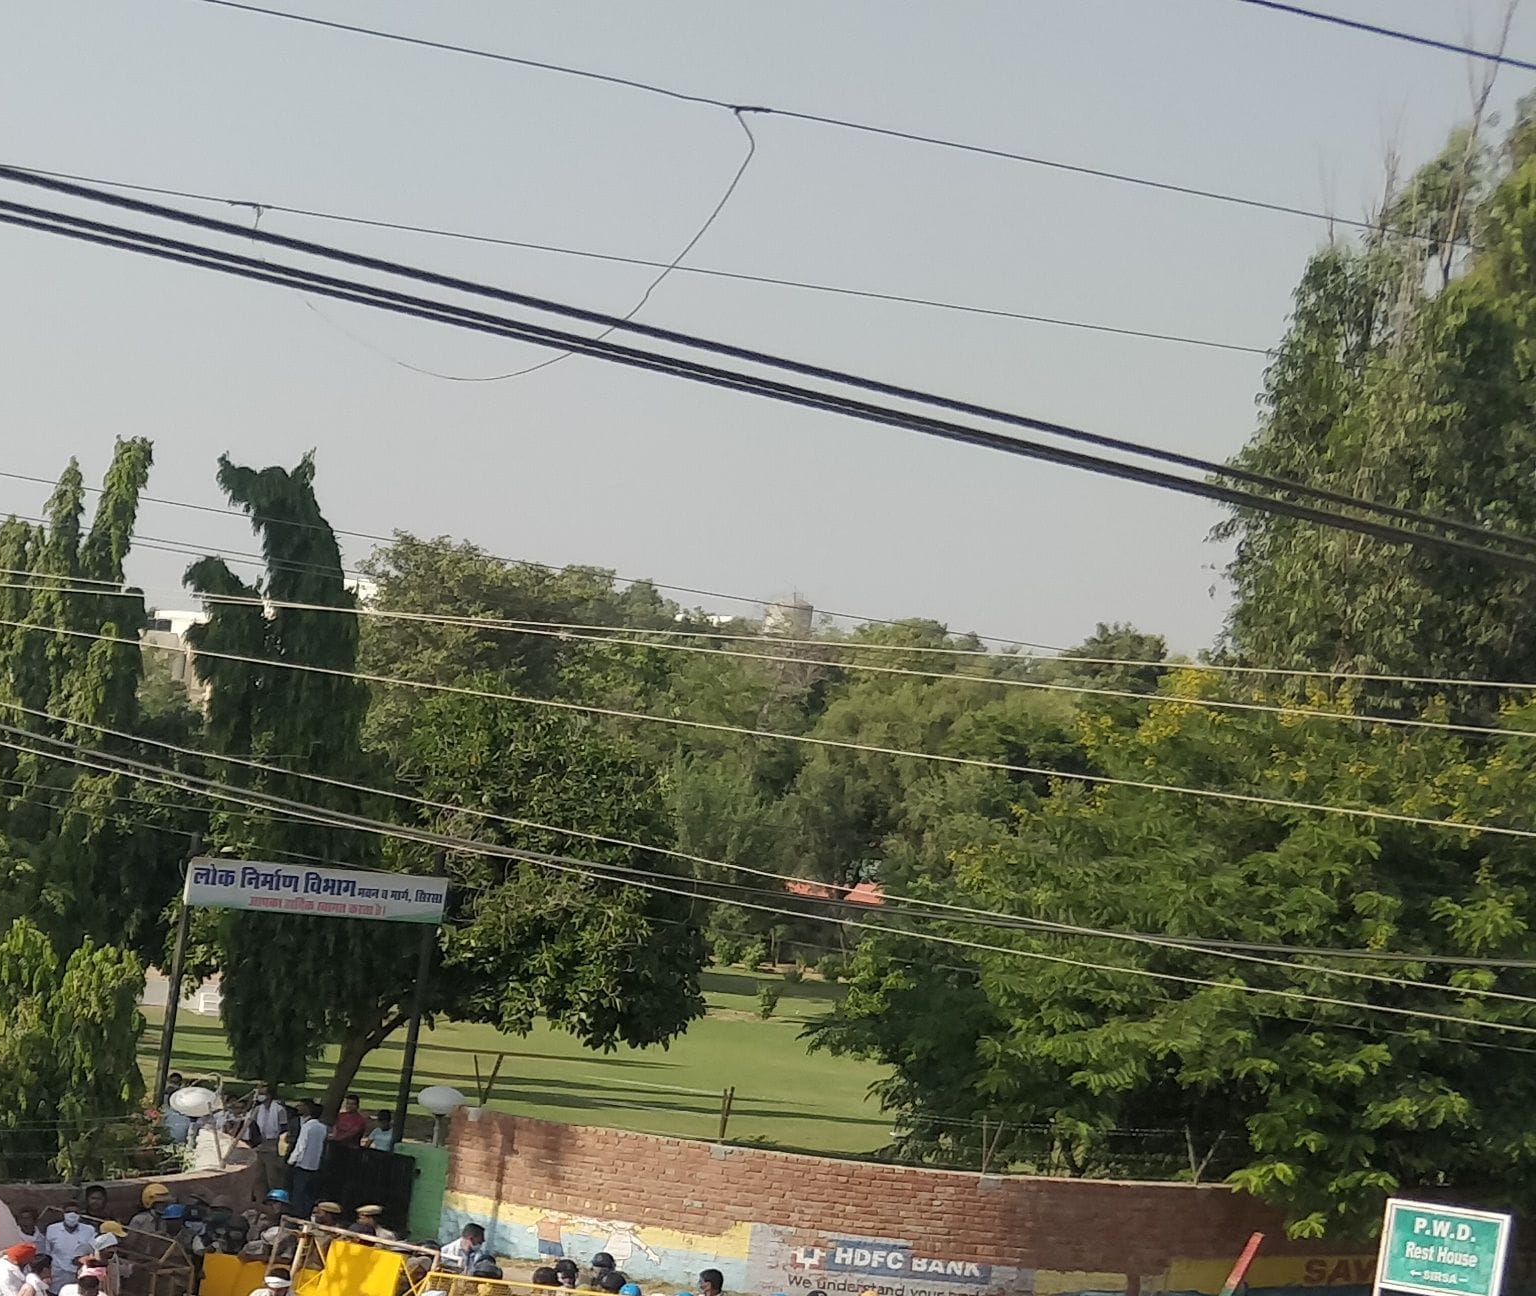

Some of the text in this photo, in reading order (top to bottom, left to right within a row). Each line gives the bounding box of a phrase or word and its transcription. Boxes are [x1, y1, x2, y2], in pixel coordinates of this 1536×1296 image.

[193, 863, 235, 887] लोक
[240, 866, 300, 893] निर्माण
[303, 871, 356, 897] विभाग
[1413, 1216, 1476, 1243] P.W.D.
[834, 1247, 982, 1278] HDFC BANK
[1404, 1241, 1478, 1268] Rest House
[788, 1274, 813, 1289] We
[1422, 1269, 1457, 1284] SIRSA
